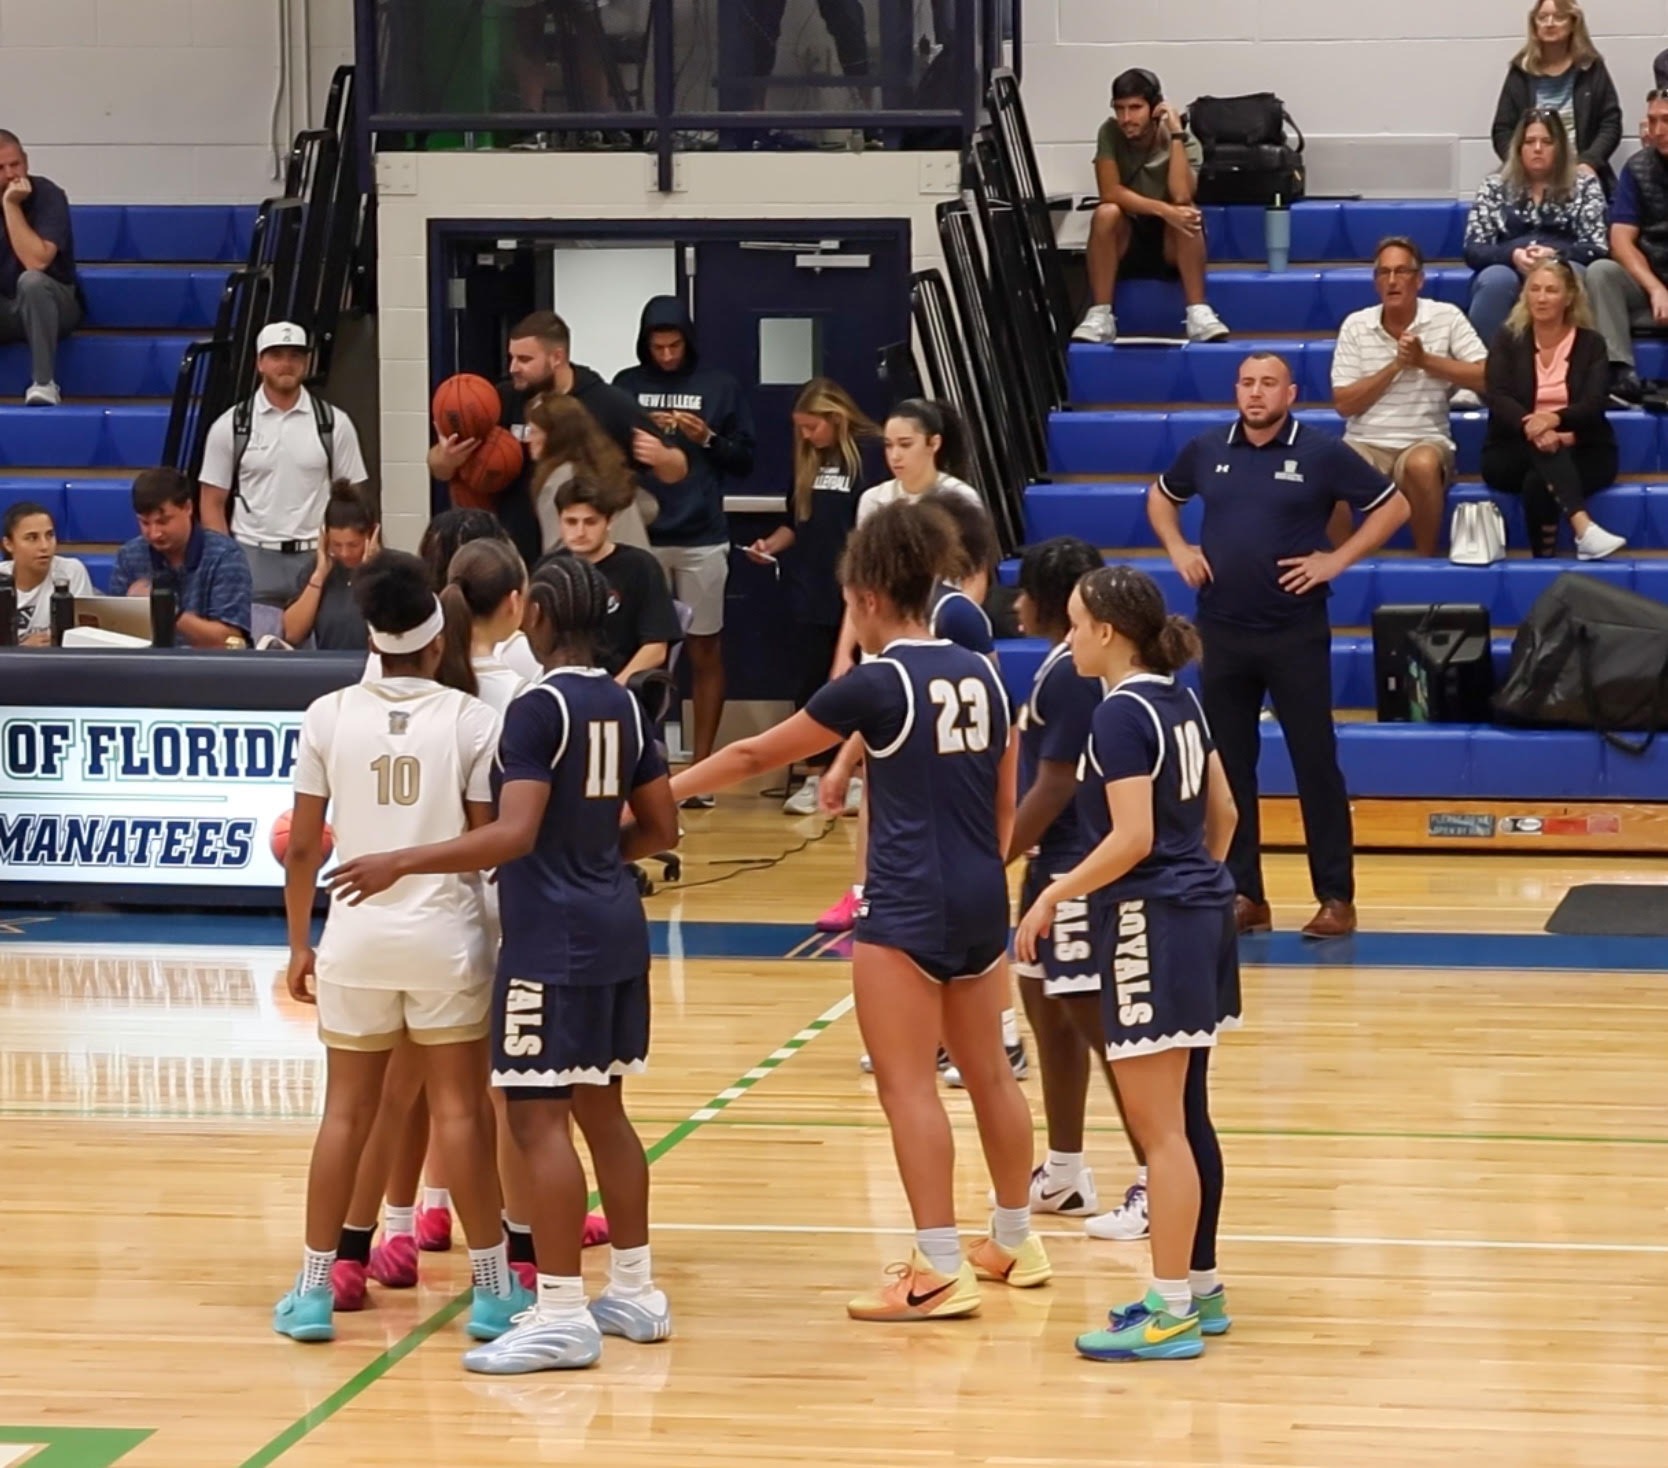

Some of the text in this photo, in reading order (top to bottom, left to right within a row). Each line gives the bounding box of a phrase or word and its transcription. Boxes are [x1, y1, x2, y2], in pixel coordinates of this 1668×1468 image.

[929, 677, 989, 754] 23
[6, 722, 302, 779] OF FLORIDA
[370, 755, 421, 806] 10
[585, 720, 620, 798] 11
[1173, 719, 1206, 800] 10
[0, 816, 256, 868] MANATEES
[1054, 896, 1091, 962] ALS
